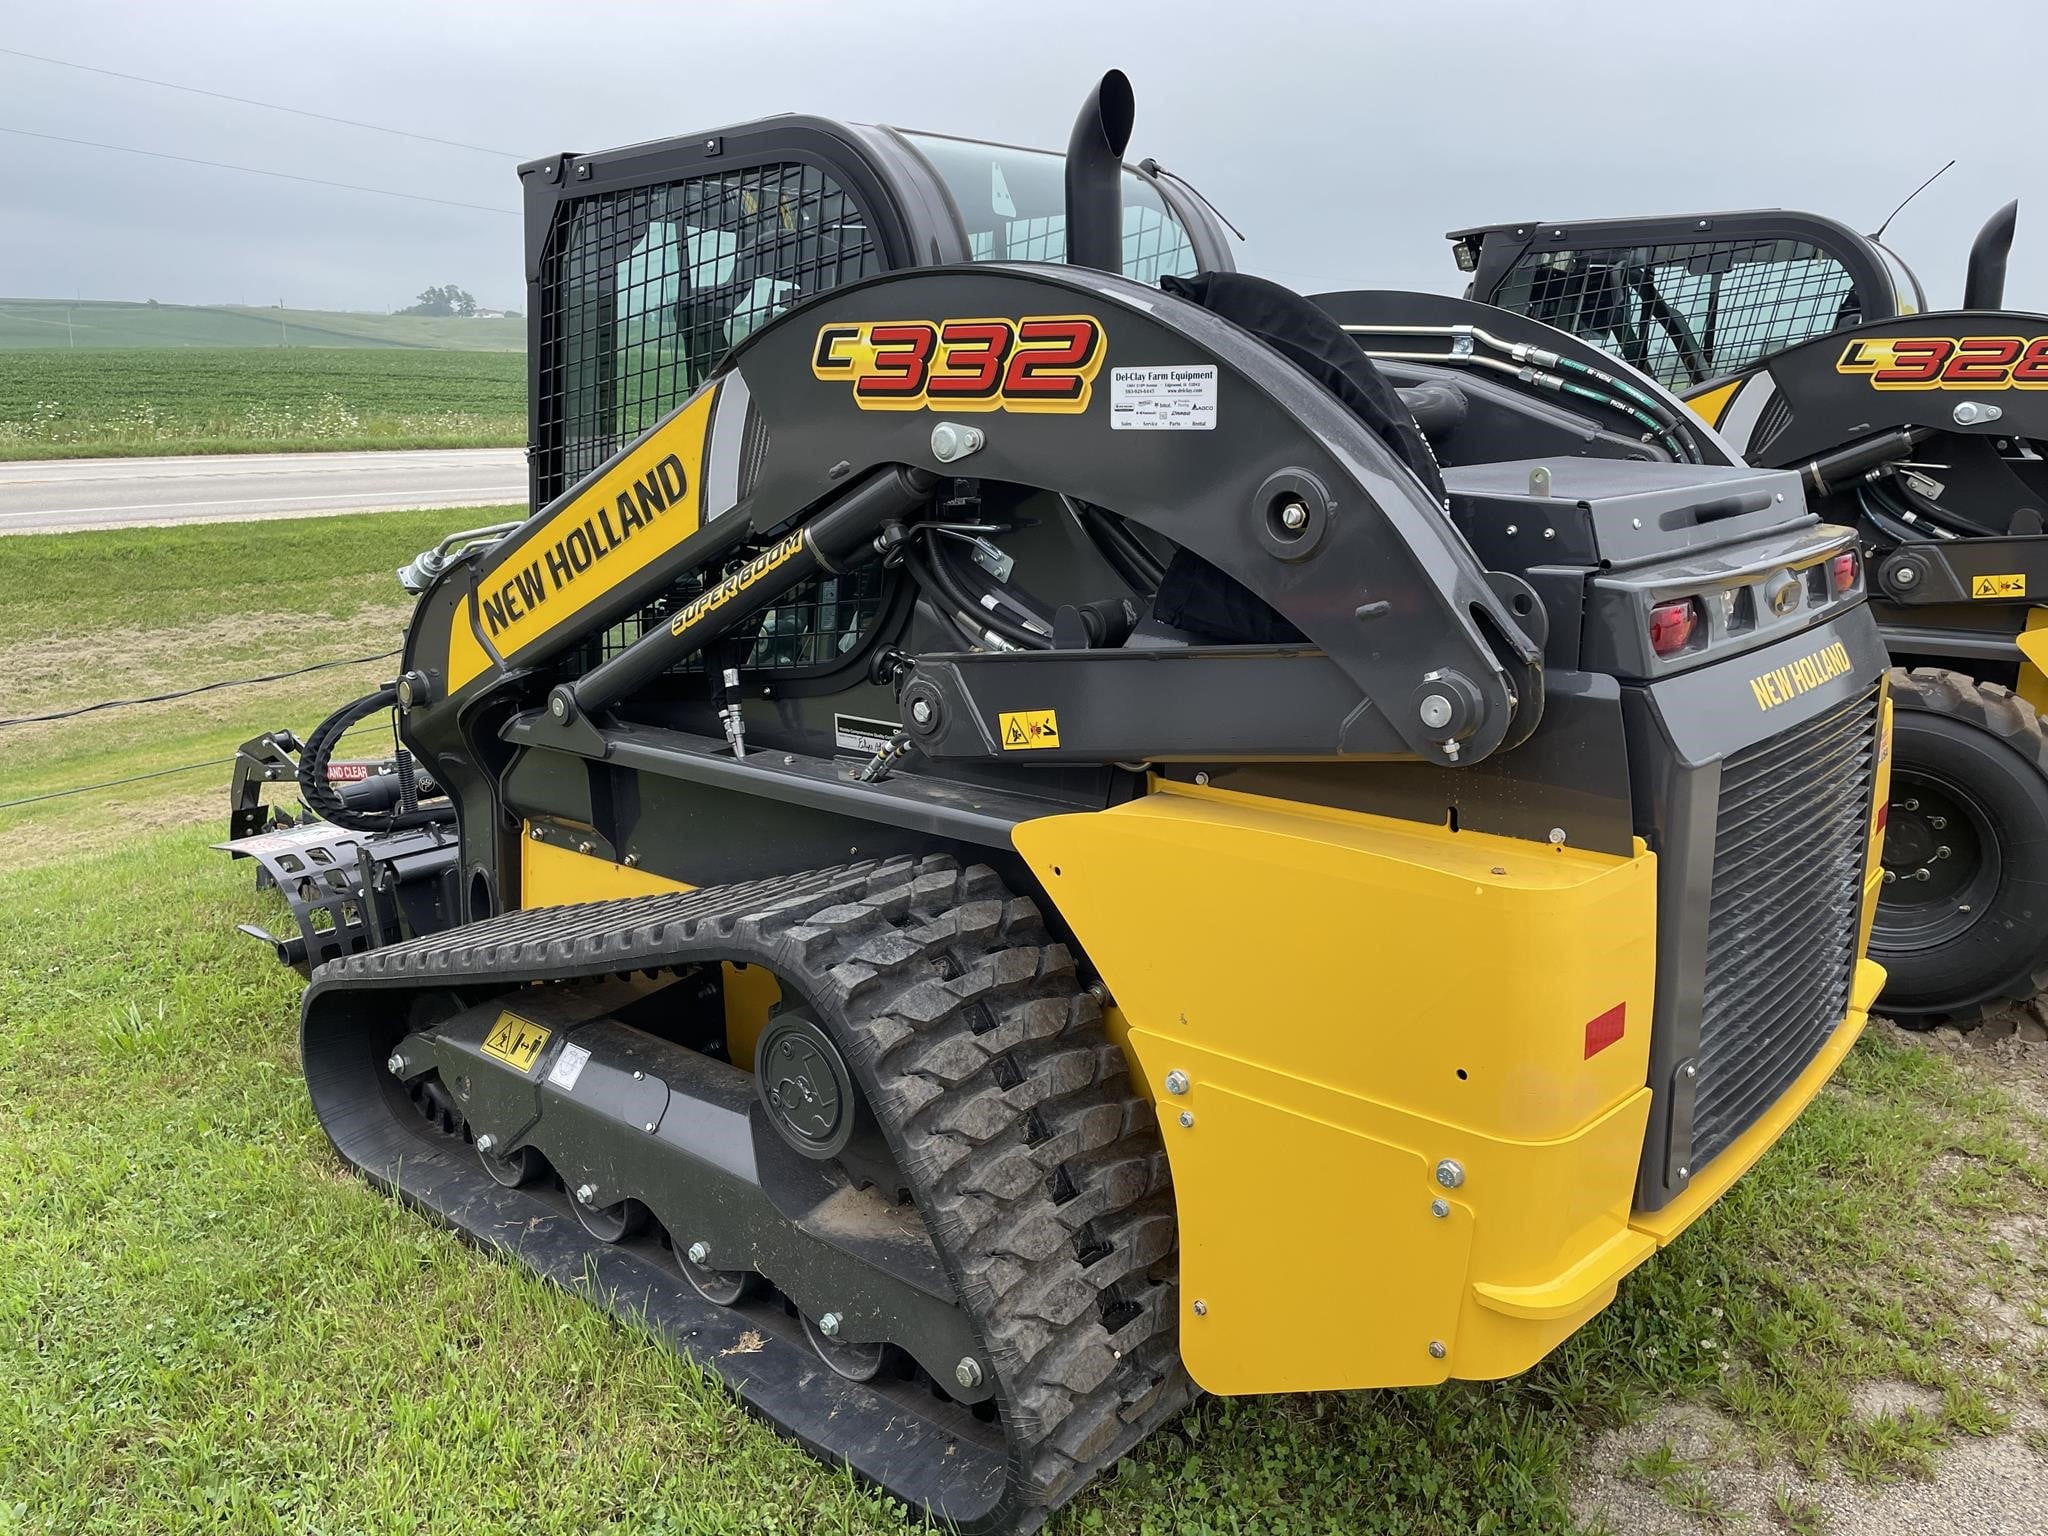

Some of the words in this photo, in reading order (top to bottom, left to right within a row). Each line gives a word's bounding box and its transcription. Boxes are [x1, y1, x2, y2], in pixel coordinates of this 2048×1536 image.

[814, 317, 1103, 407] C332
[1115, 372, 1146, 382] Del-Clay
[1148, 372, 1168, 380] Farm
[1170, 371, 1213, 381] Equipment
[483, 560, 546, 637] NEW
[544, 453, 688, 592] HOLLAND
[672, 575, 738, 636] SUPER
[739, 528, 803, 590] BOOM
[1750, 666, 1795, 711] NEW
[1788, 641, 1851, 694] HOLLAND
[328, 766, 343, 778] AND
[344, 766, 368, 778] CLEAR
